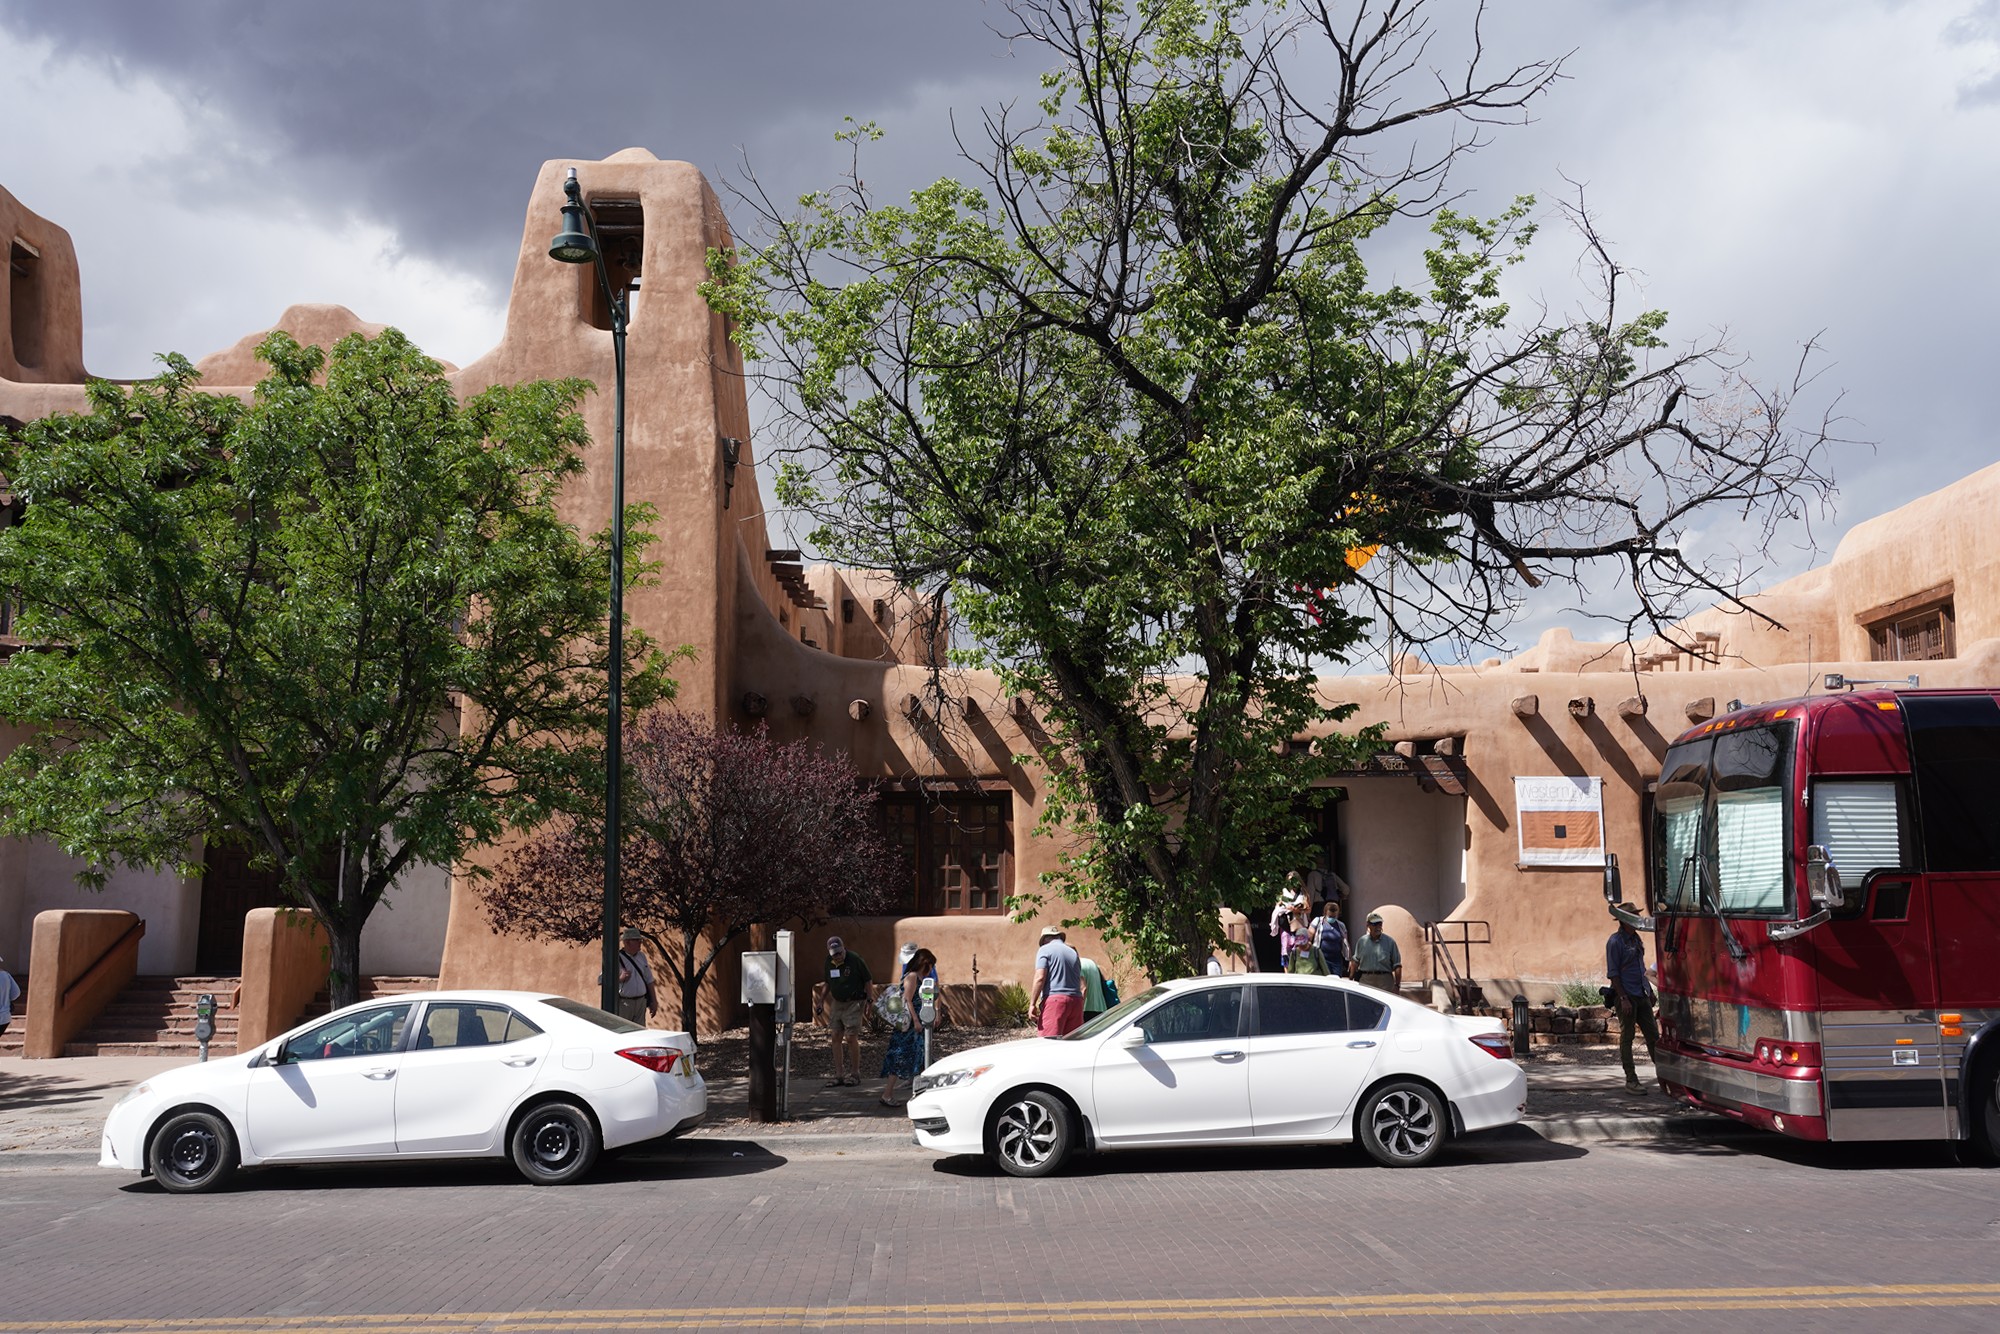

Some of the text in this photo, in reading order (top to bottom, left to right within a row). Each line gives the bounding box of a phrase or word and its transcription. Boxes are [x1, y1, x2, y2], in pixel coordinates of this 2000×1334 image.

[1359, 761, 1375, 771] OF
[1383, 761, 1406, 770] ART
[1519, 784, 1569, 799] Western
